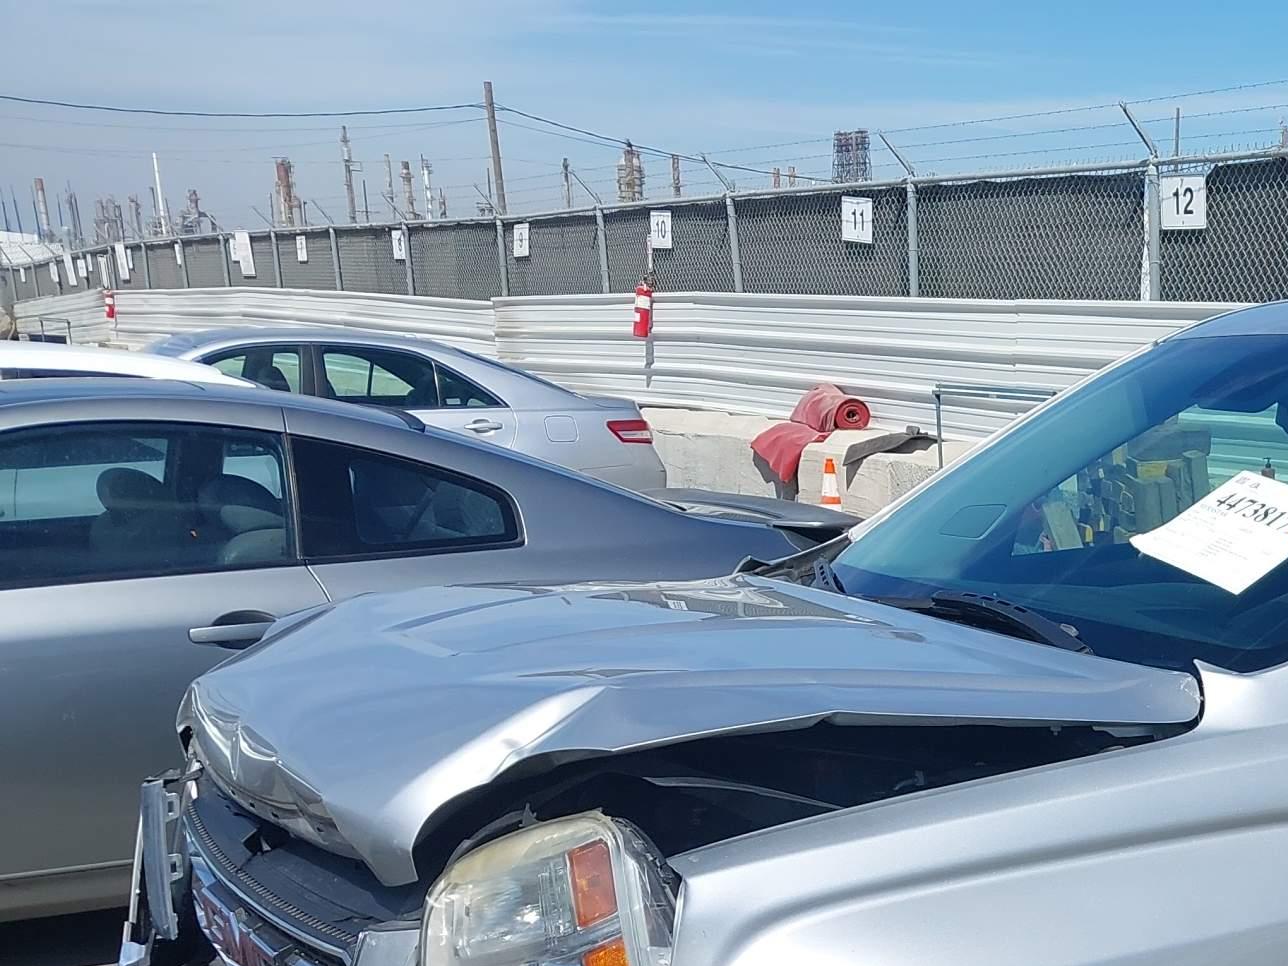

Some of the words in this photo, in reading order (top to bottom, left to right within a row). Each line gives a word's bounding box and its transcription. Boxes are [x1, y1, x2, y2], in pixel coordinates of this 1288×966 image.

[1172, 187, 1194, 215] 12
[655, 220, 667, 239] 10
[851, 208, 865, 232] 11
